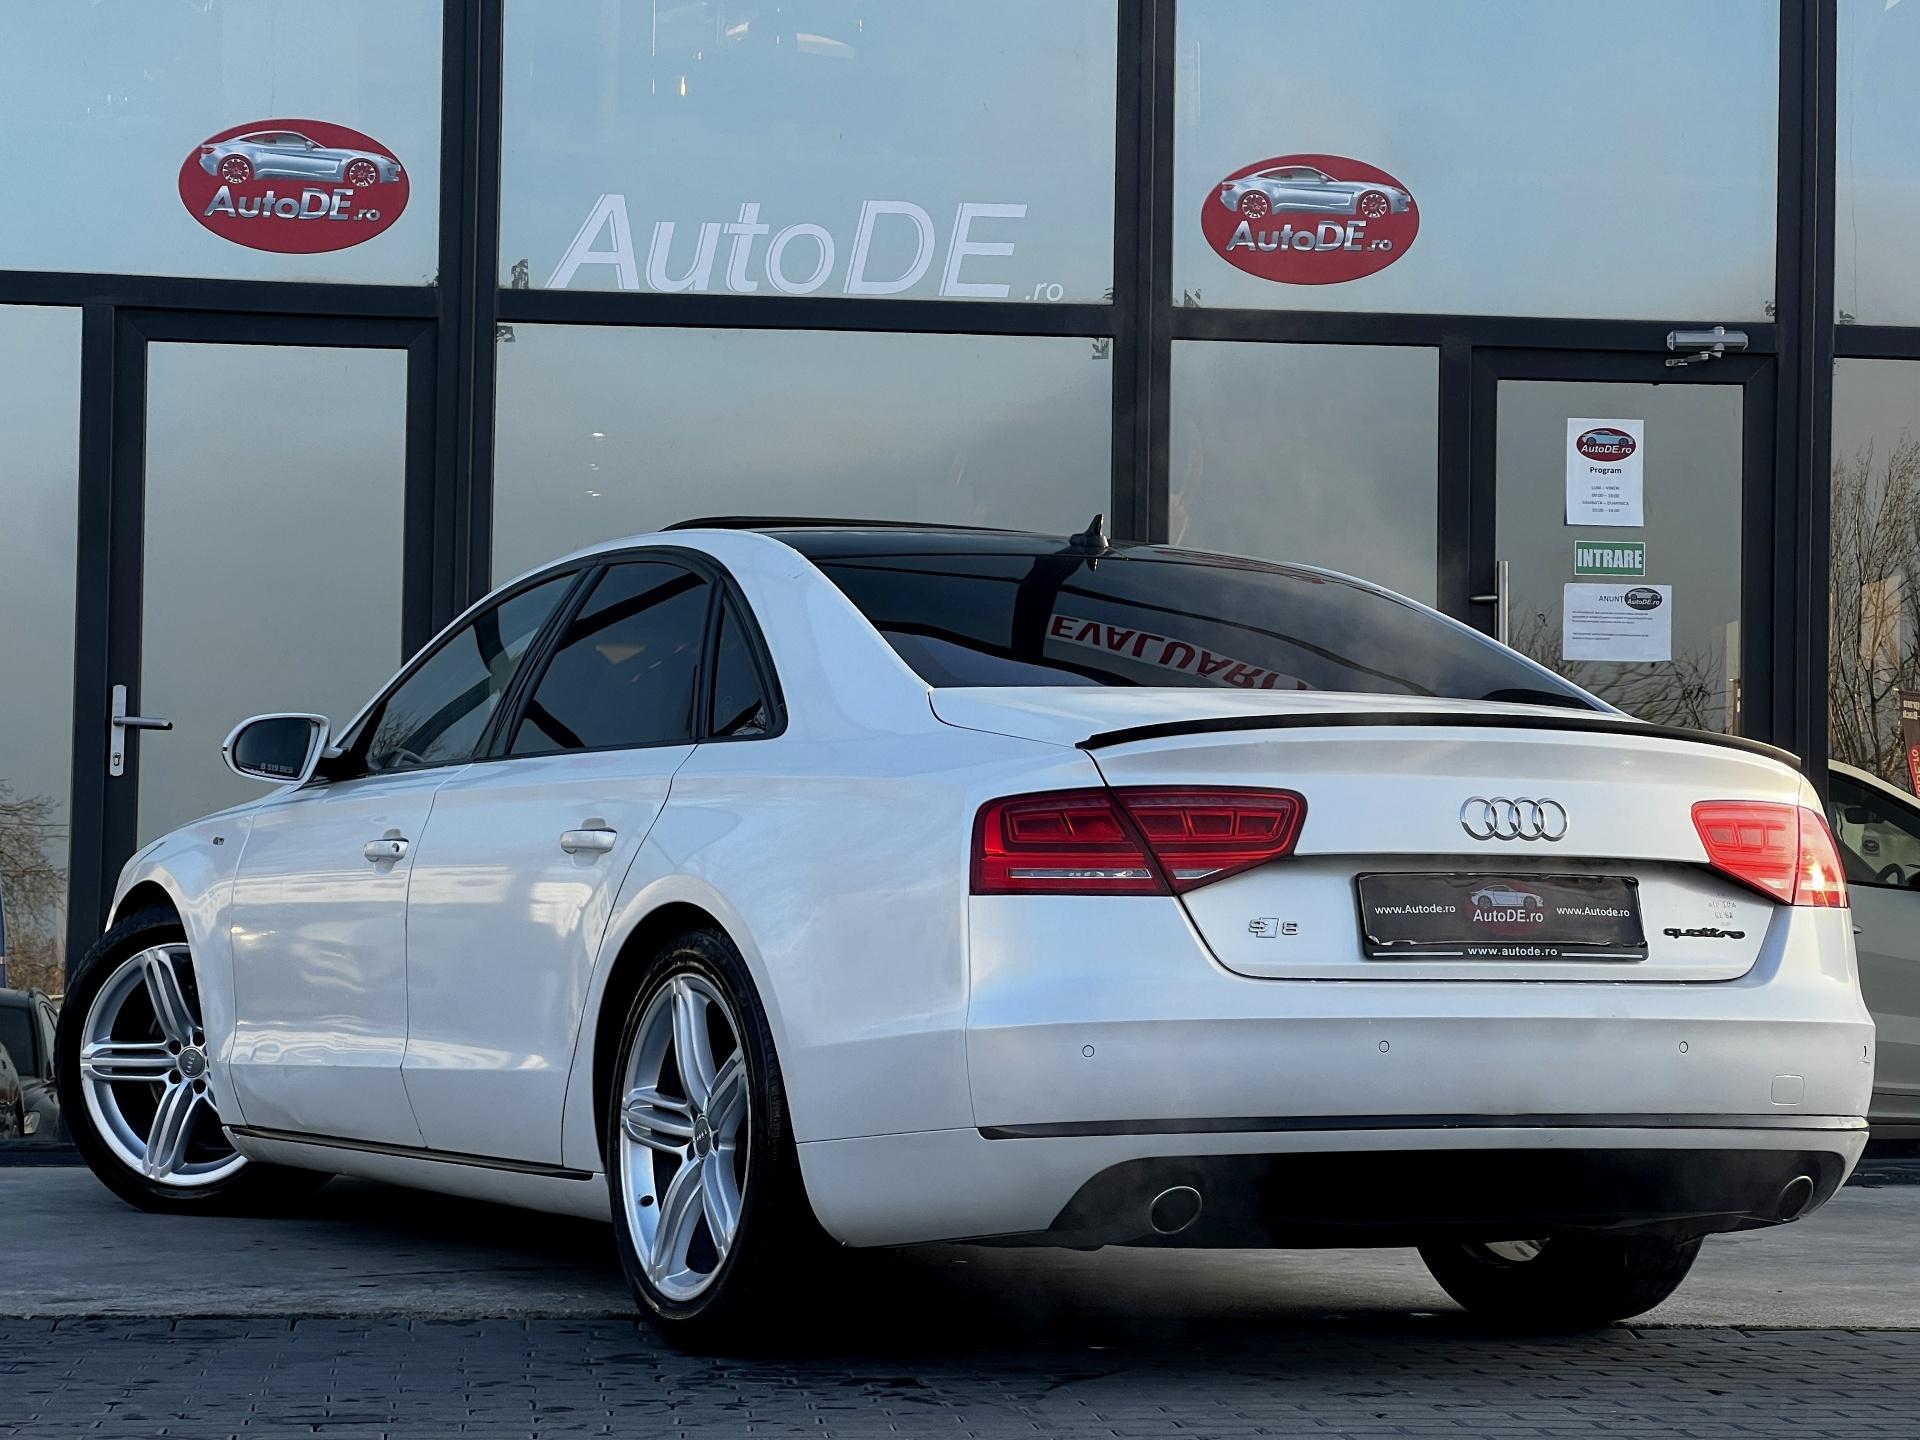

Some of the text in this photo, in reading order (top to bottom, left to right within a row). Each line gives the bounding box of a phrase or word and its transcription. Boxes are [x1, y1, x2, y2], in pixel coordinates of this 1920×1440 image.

[1581, 444, 1632, 455] AutoDE.ro
[1590, 466, 1622, 475] Program
[1577, 548, 1643, 569] INTRARE
[1374, 903, 1457, 916] www.Autode.ro
[1556, 904, 1631, 918] www.Autode.ro
[1473, 908, 1545, 924] AutoDE.ro
[1663, 927, 1746, 939] quattro
[1467, 946, 1559, 957] www.autode.ro
